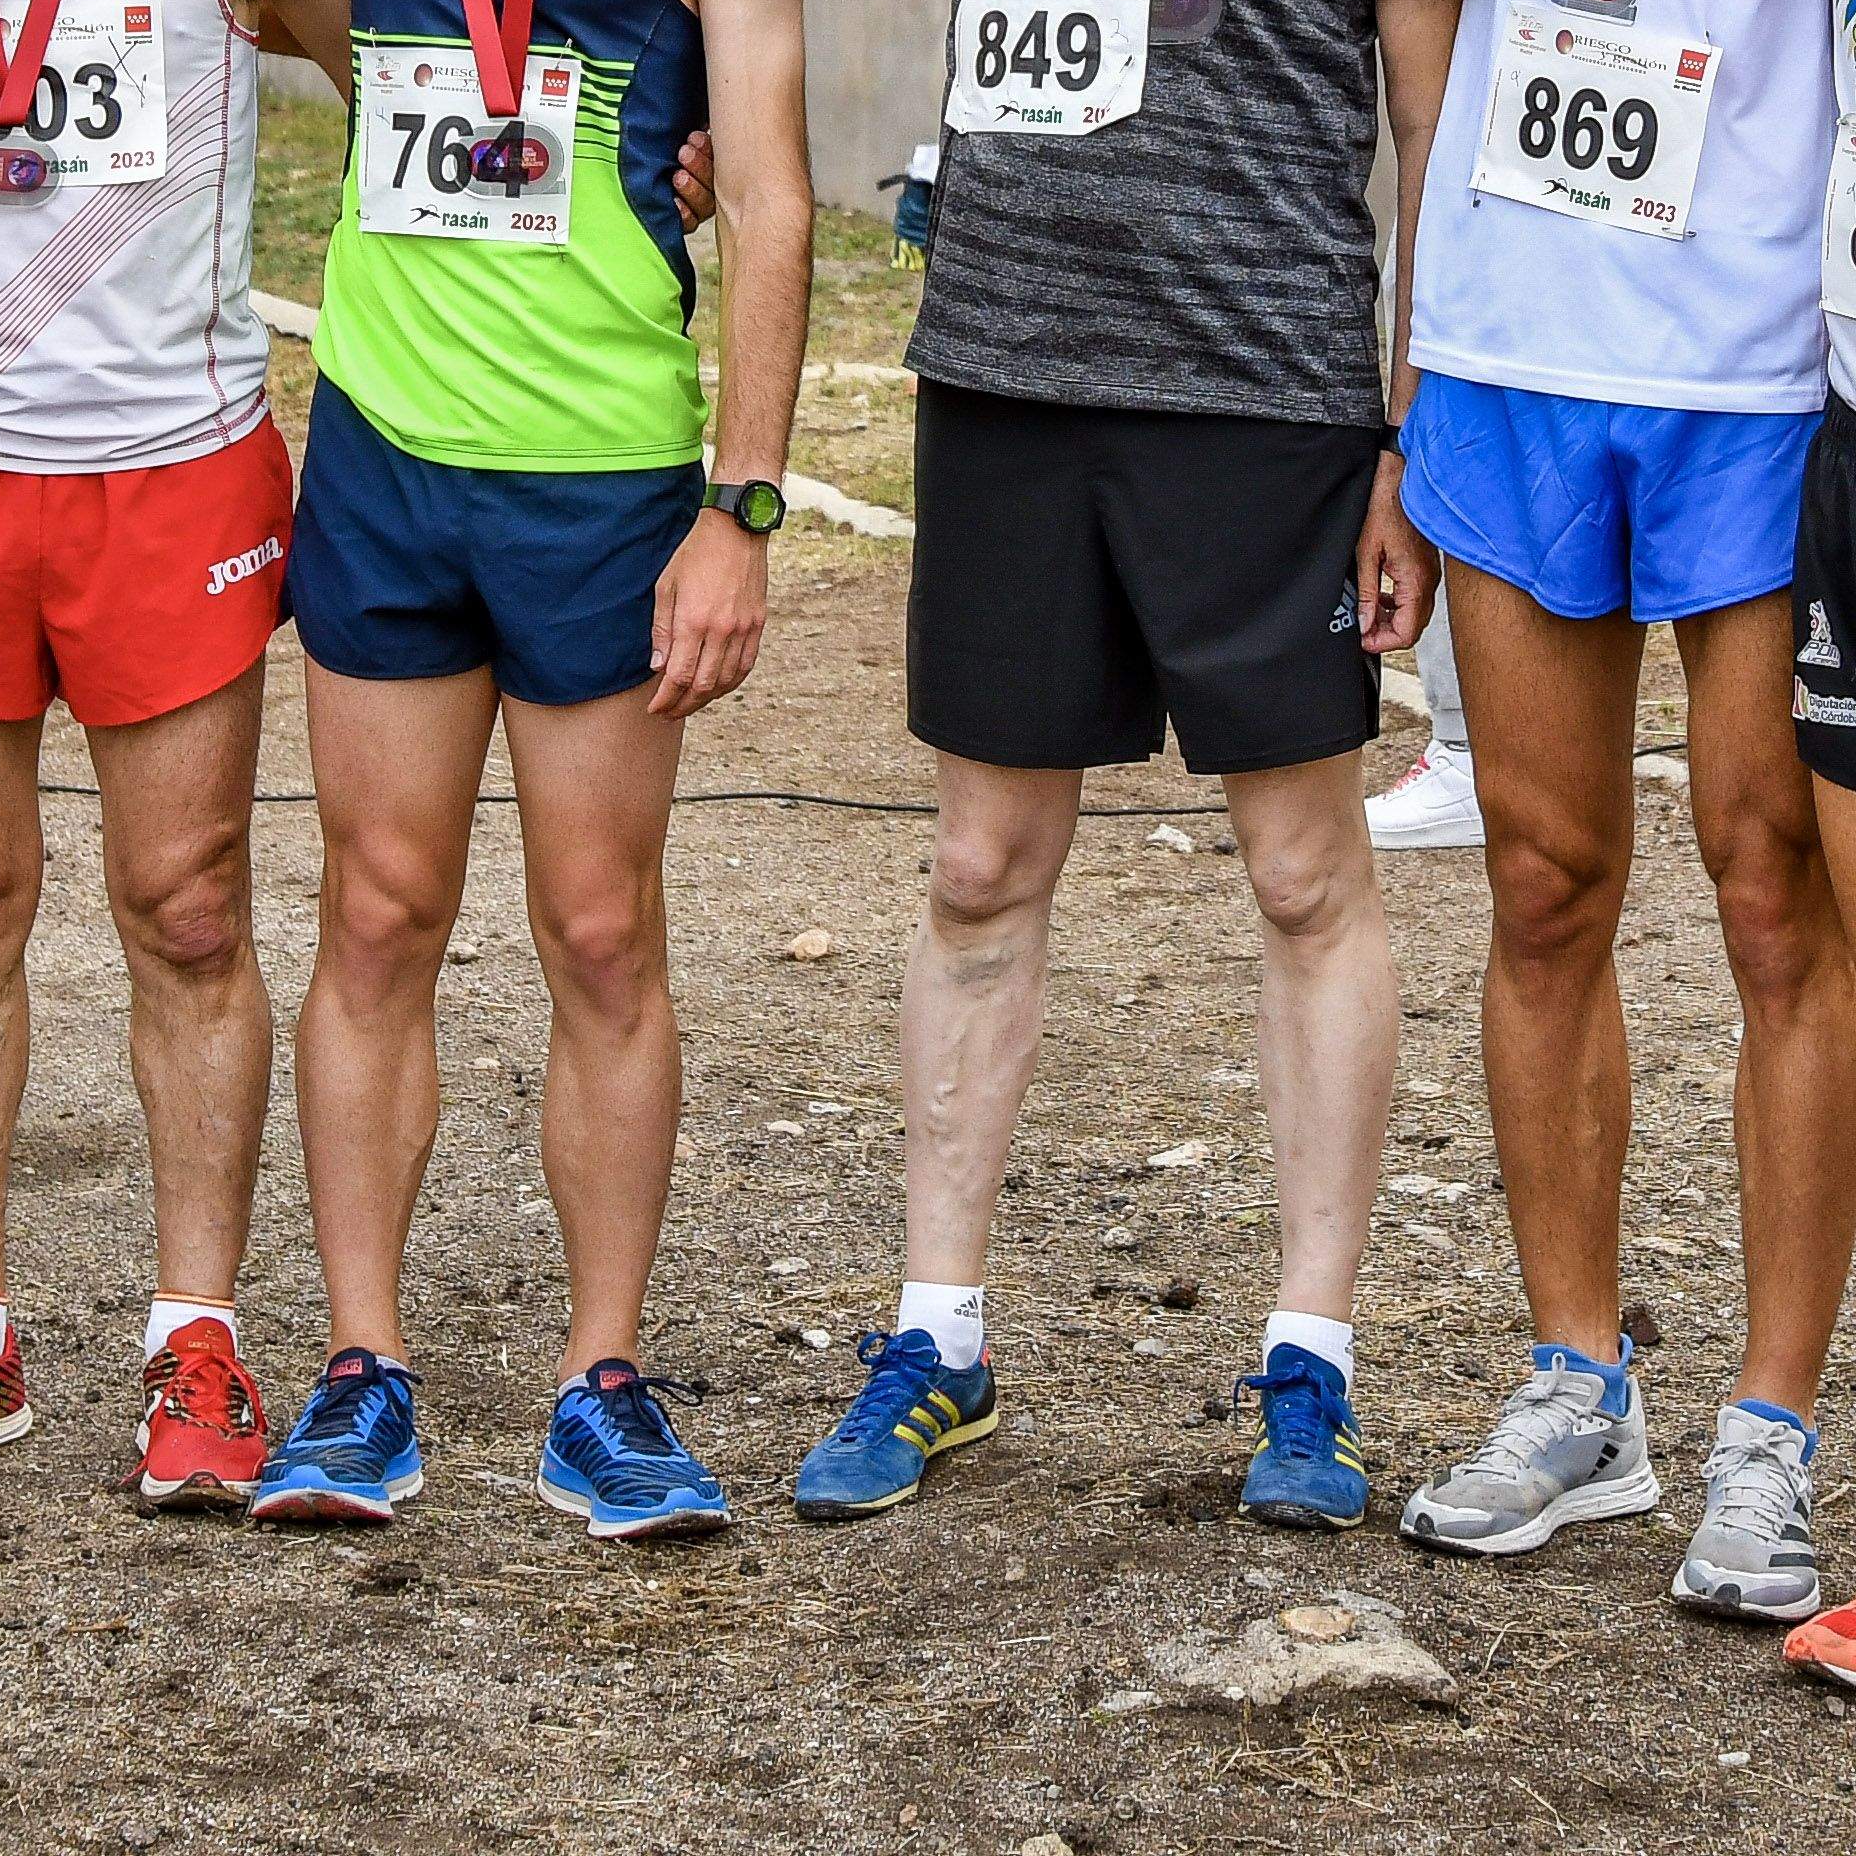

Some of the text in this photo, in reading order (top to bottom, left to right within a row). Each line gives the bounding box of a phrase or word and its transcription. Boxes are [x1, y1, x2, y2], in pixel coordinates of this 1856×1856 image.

[976, 10, 1101, 92] 849
[1575, 33, 1632, 55] RIESGO
[1021, 106, 1063, 124] rasán
[1519, 76, 1658, 181] 869
[110, 151, 155, 170] 2023
[392, 113, 528, 198] 764
[1569, 189, 1611, 211] rasán
[1631, 197, 1677, 223] 2023
[441, 211, 489, 229] rasán
[511, 213, 557, 231] 2023
[1810, 709, 1820, 719] de
